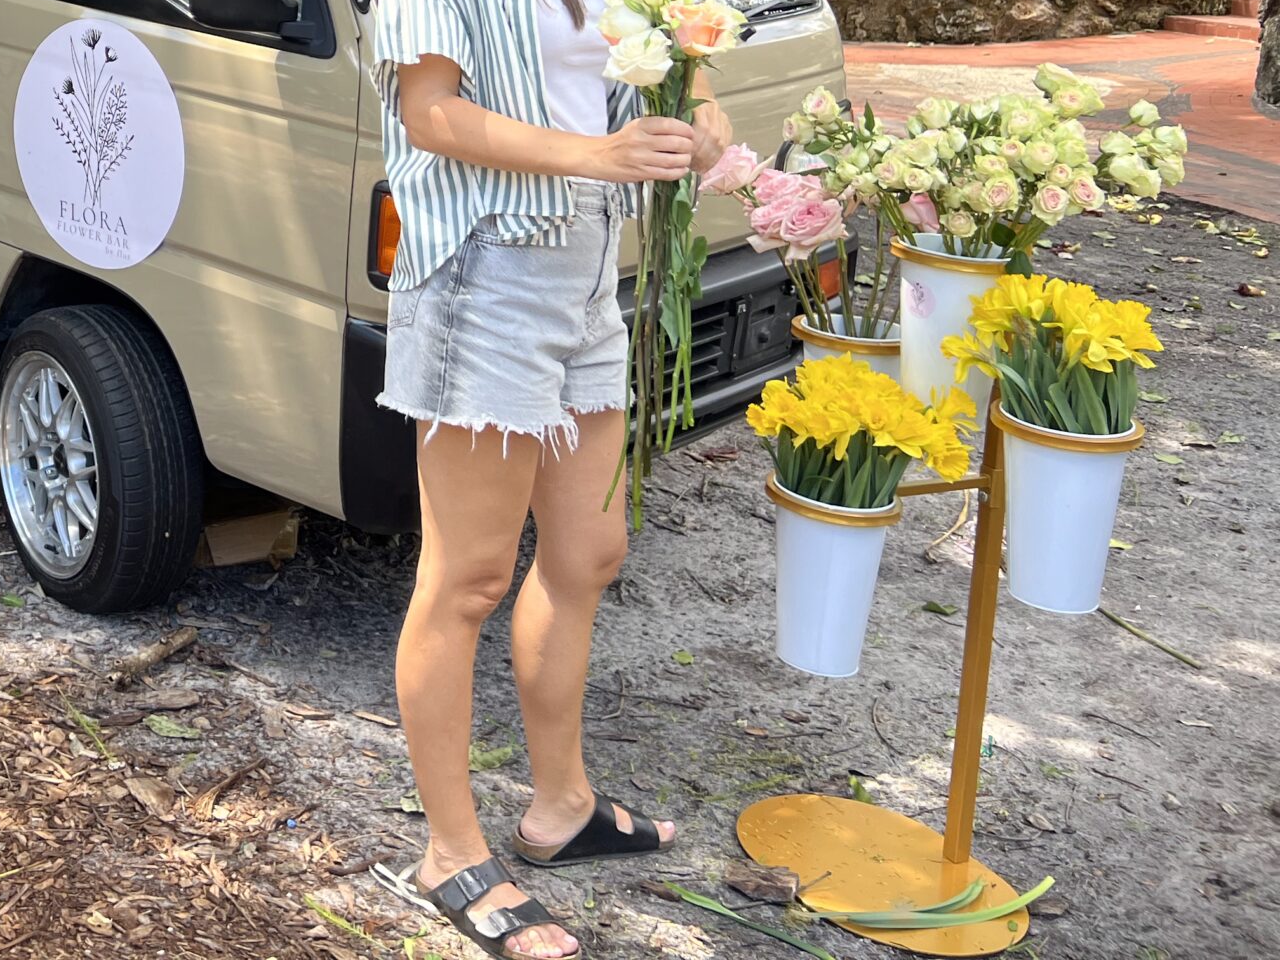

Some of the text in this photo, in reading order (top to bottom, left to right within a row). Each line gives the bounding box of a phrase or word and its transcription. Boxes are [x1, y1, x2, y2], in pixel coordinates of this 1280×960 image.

[60, 200, 128, 235] FLORA
[57, 220, 129, 250] FLOWER BAR
